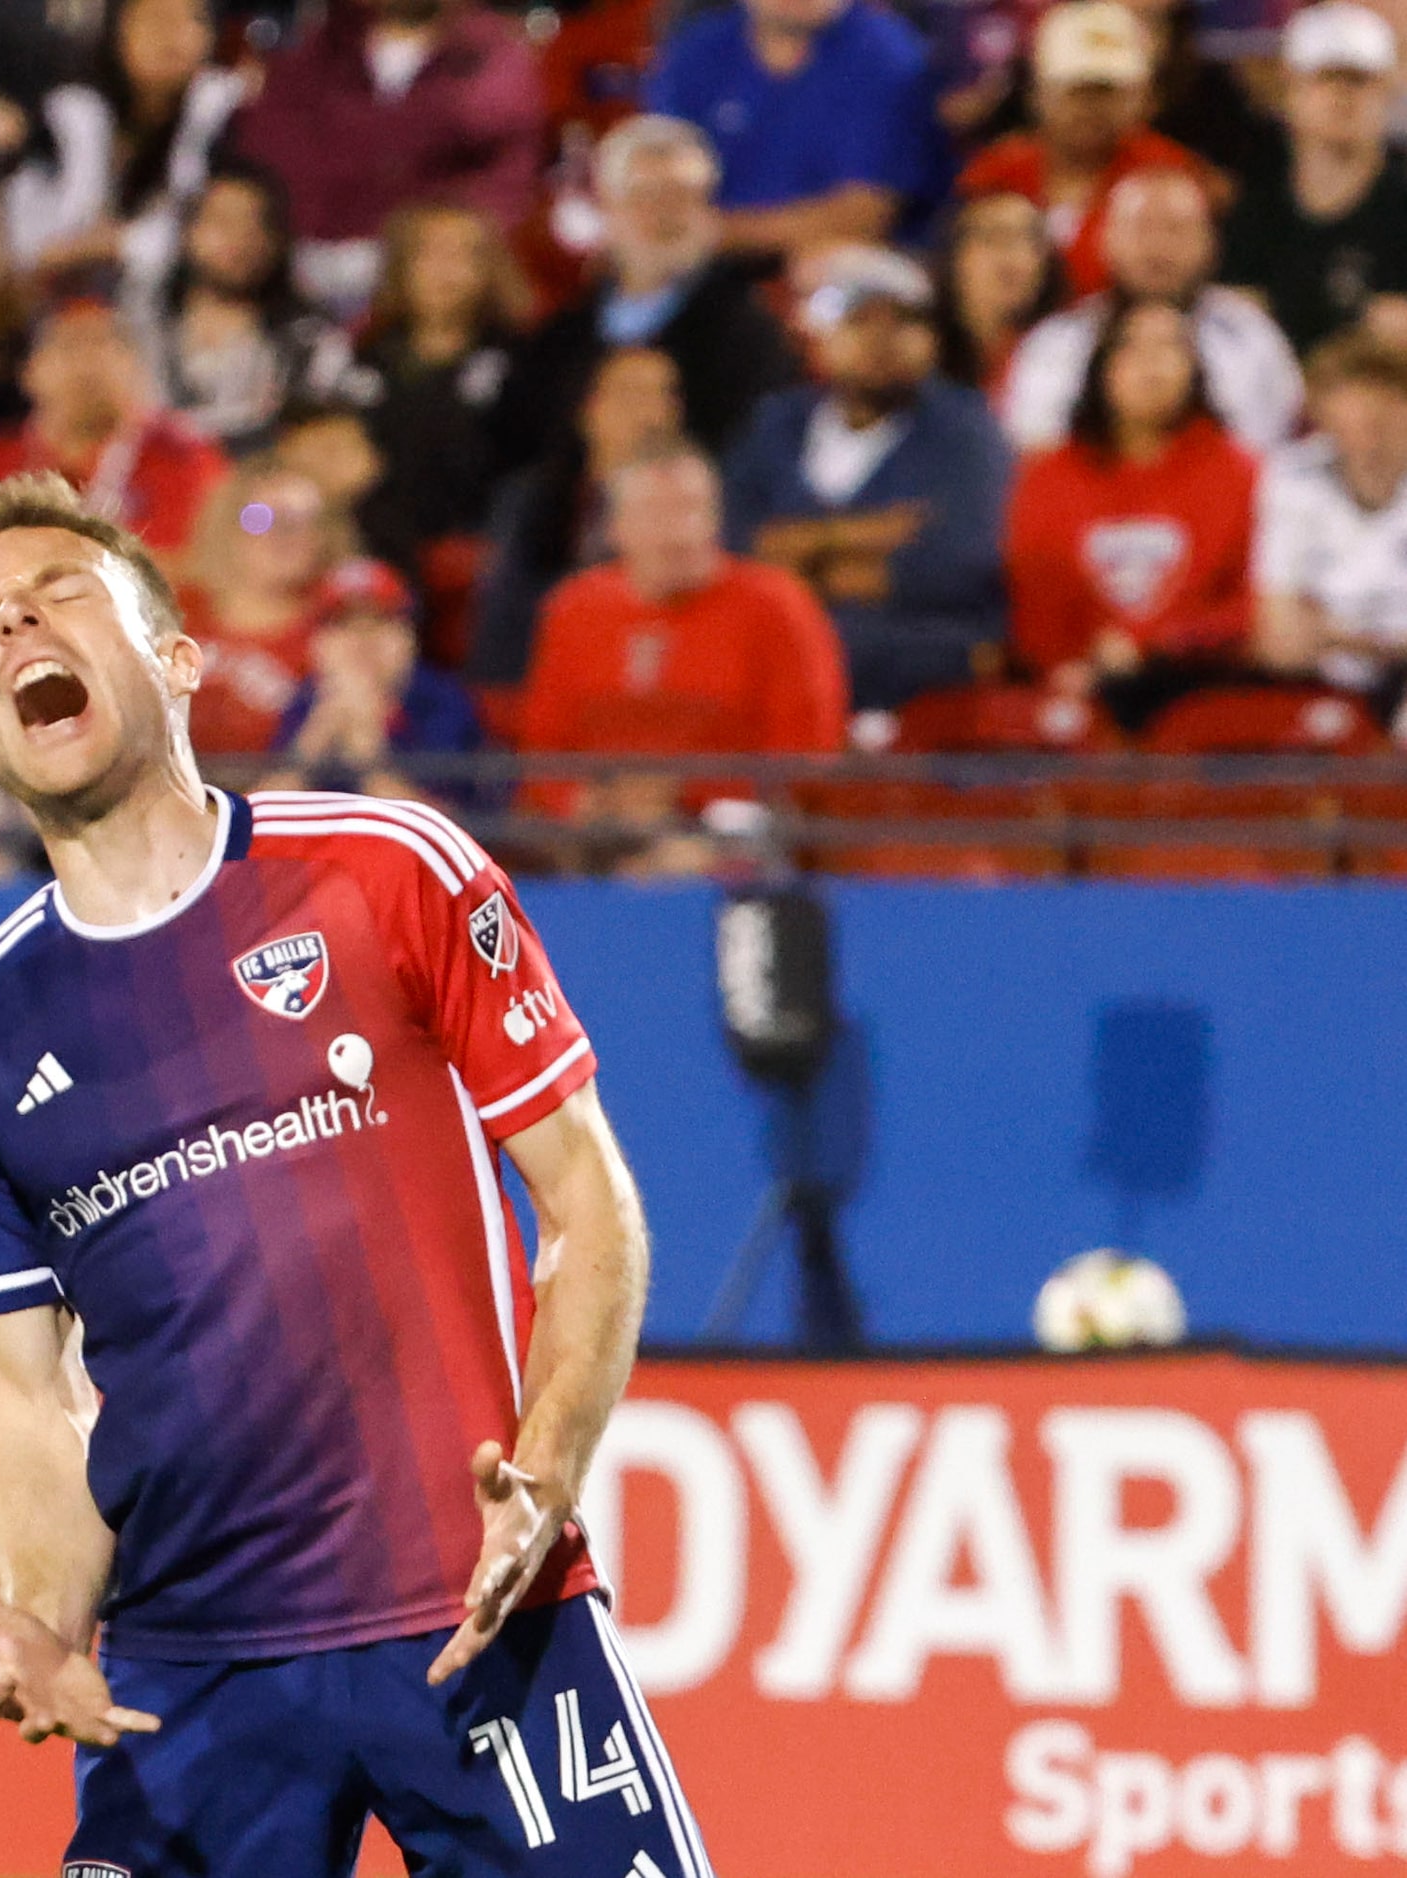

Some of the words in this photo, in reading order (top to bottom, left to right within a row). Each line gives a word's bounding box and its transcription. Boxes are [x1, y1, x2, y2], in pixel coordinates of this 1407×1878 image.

[471, 905, 497, 932] MLS
[242, 956, 262, 981] FC
[263, 937, 319, 970] DALLAS
[522, 982, 558, 1028] tv
[468, 1688, 653, 1849] 14
